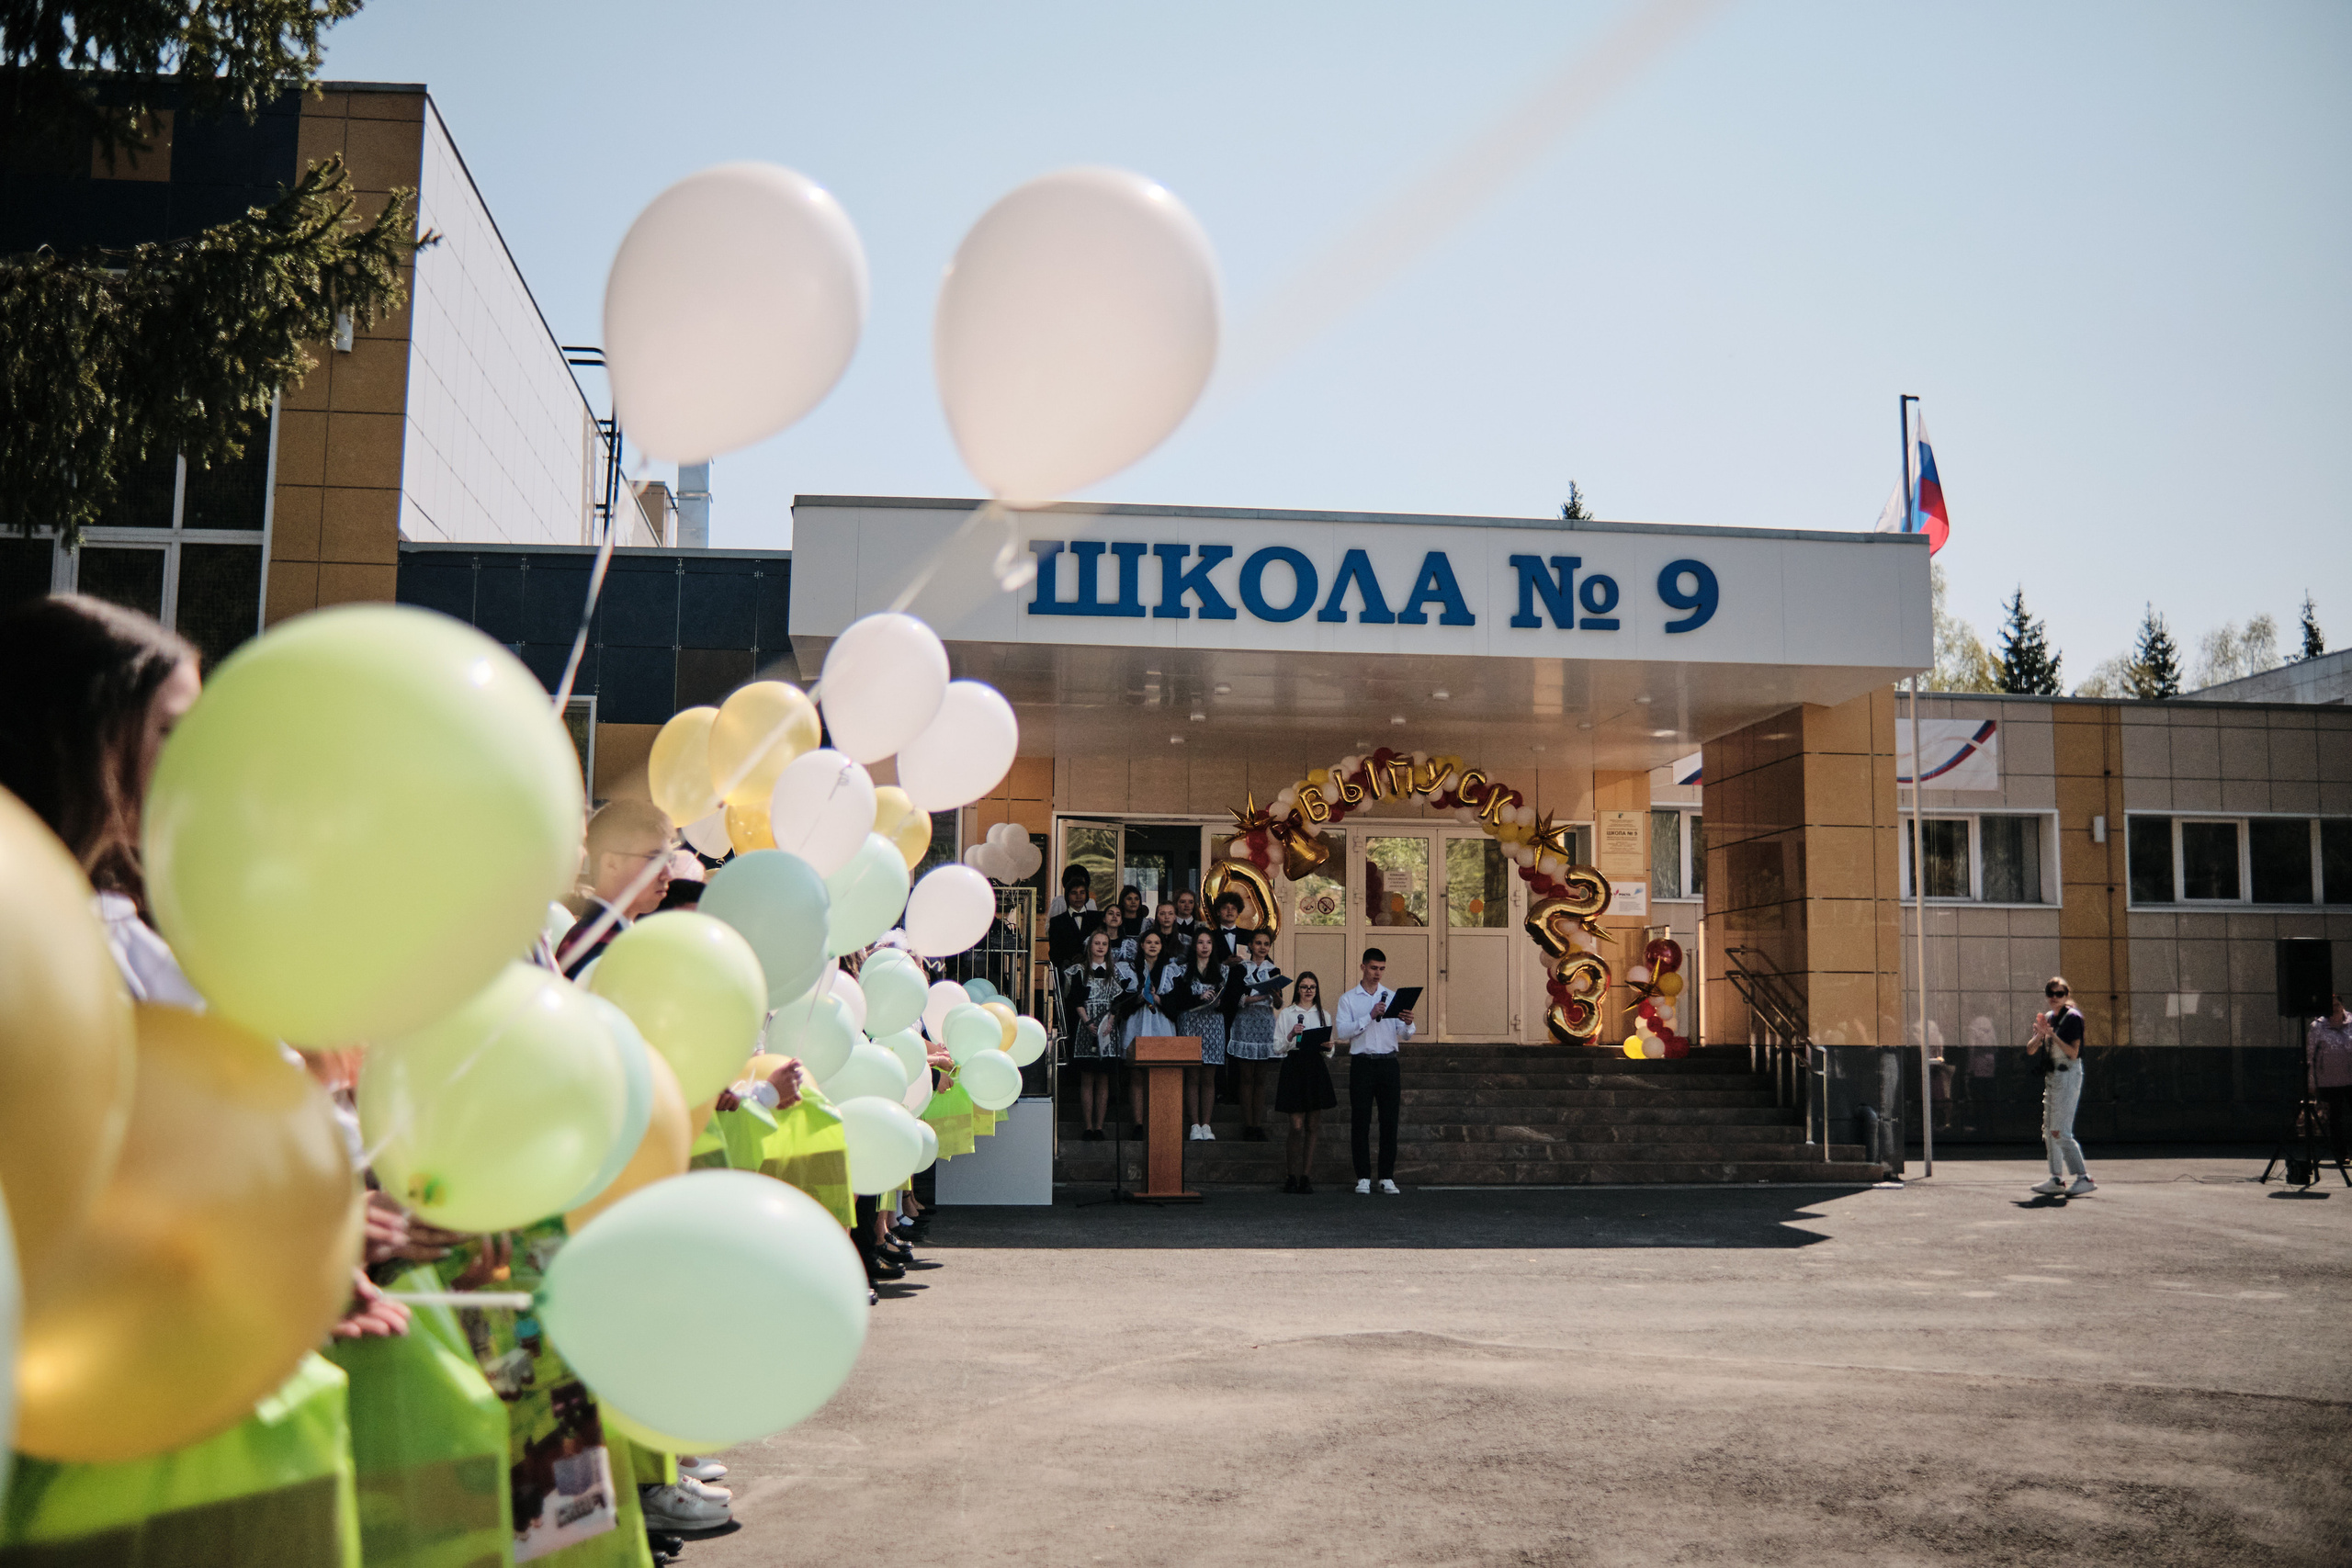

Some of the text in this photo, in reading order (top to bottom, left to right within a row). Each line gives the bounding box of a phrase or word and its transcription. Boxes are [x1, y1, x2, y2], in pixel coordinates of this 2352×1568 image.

[1027, 539, 1720, 634] ШКОЛА № 9
[1298, 756, 1514, 826] ВЫПУСК
